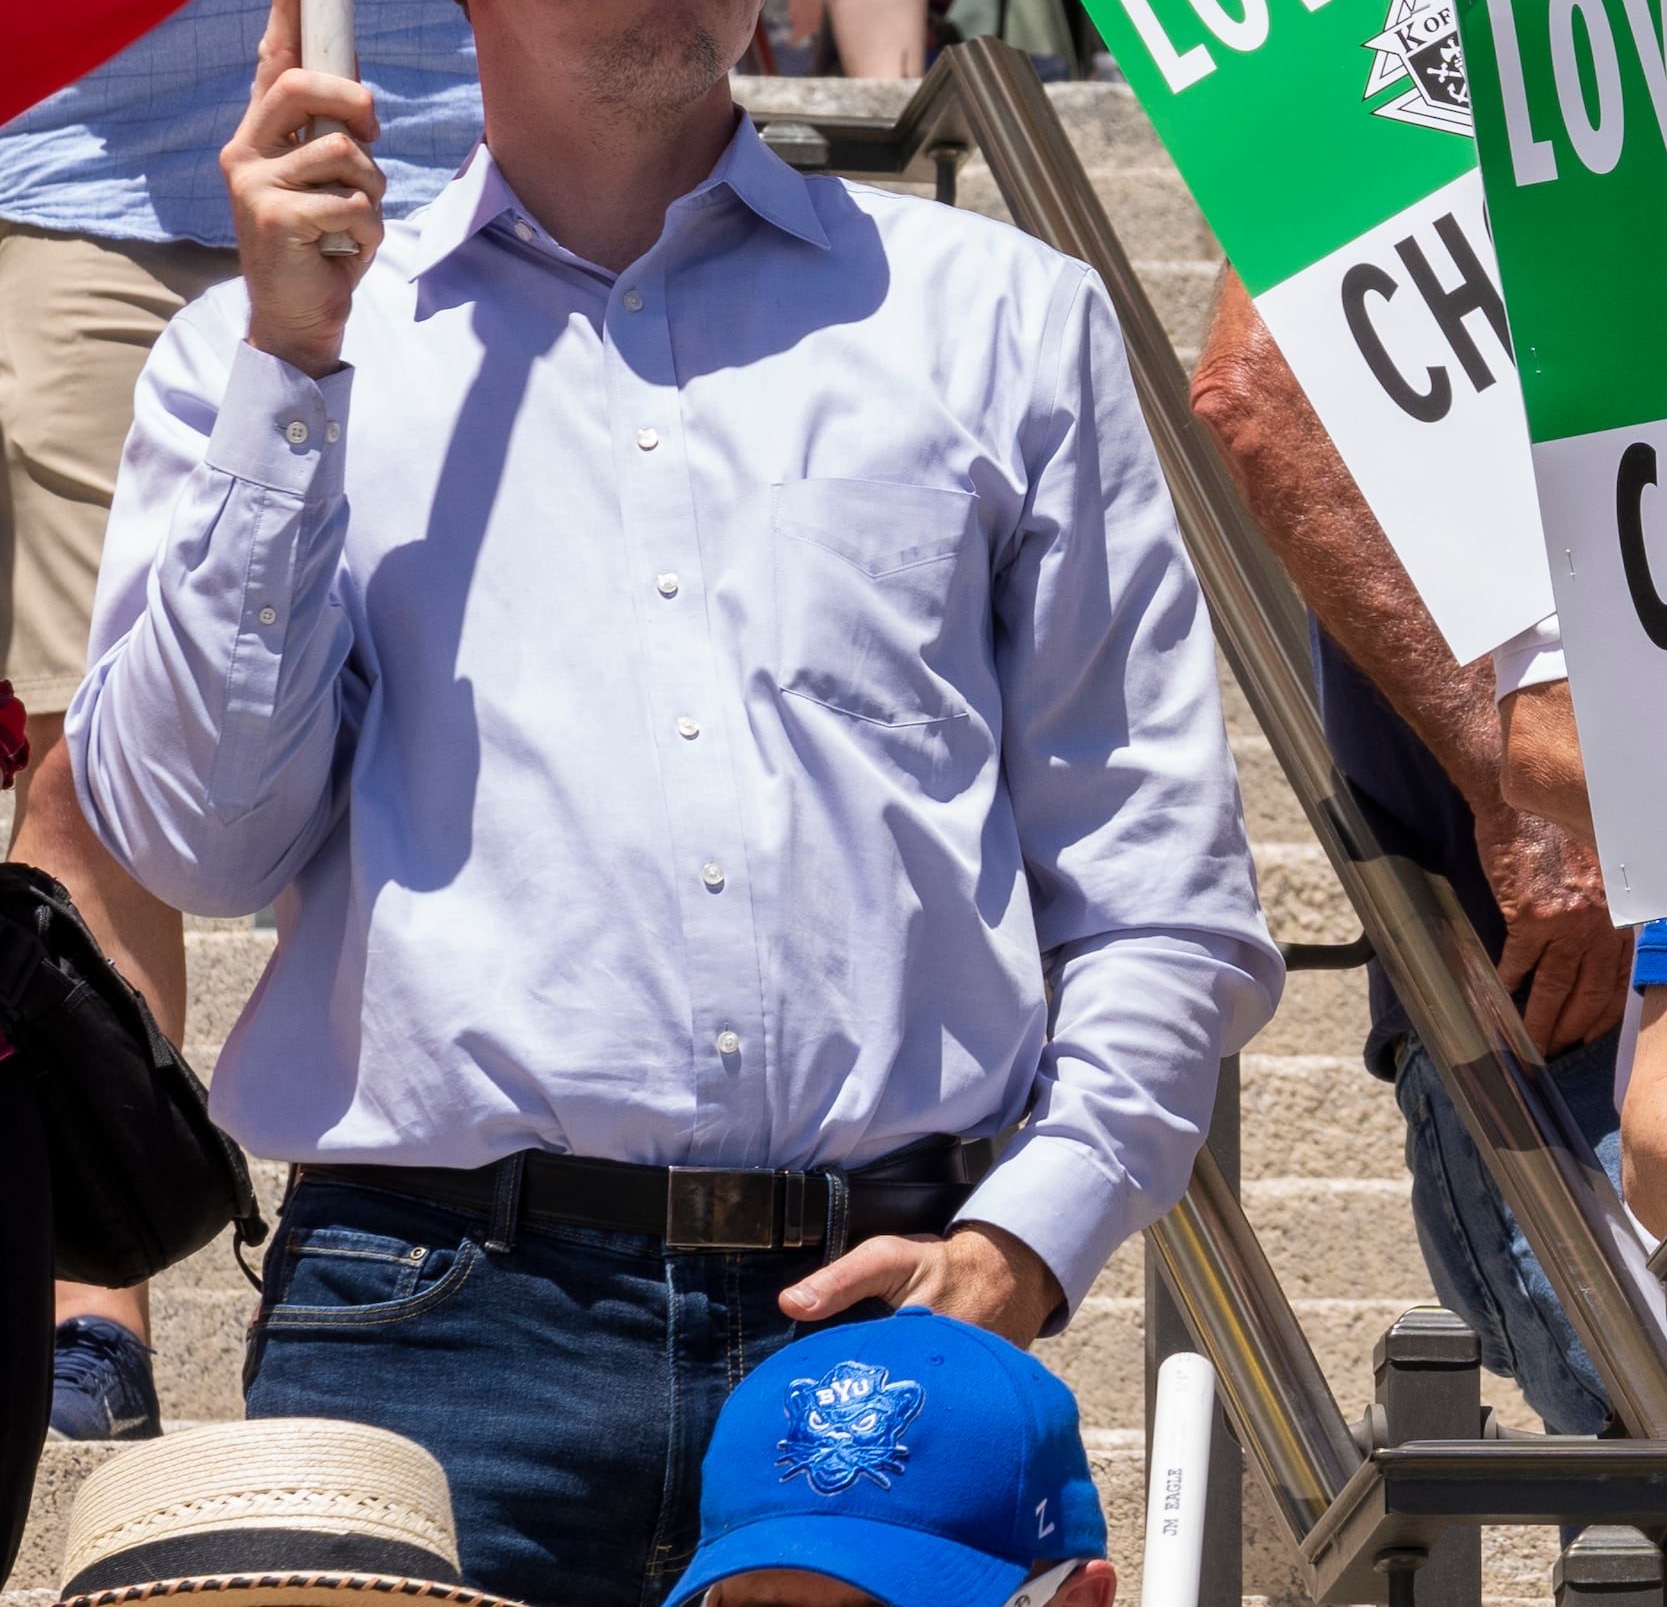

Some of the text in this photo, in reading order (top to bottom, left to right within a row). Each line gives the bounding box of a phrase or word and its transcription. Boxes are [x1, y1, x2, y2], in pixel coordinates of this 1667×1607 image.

[1397, 9, 1453, 55] K OF
[815, 1378, 870, 1406] BYU
[1162, 1468, 1184, 1537] JM EAGLE
